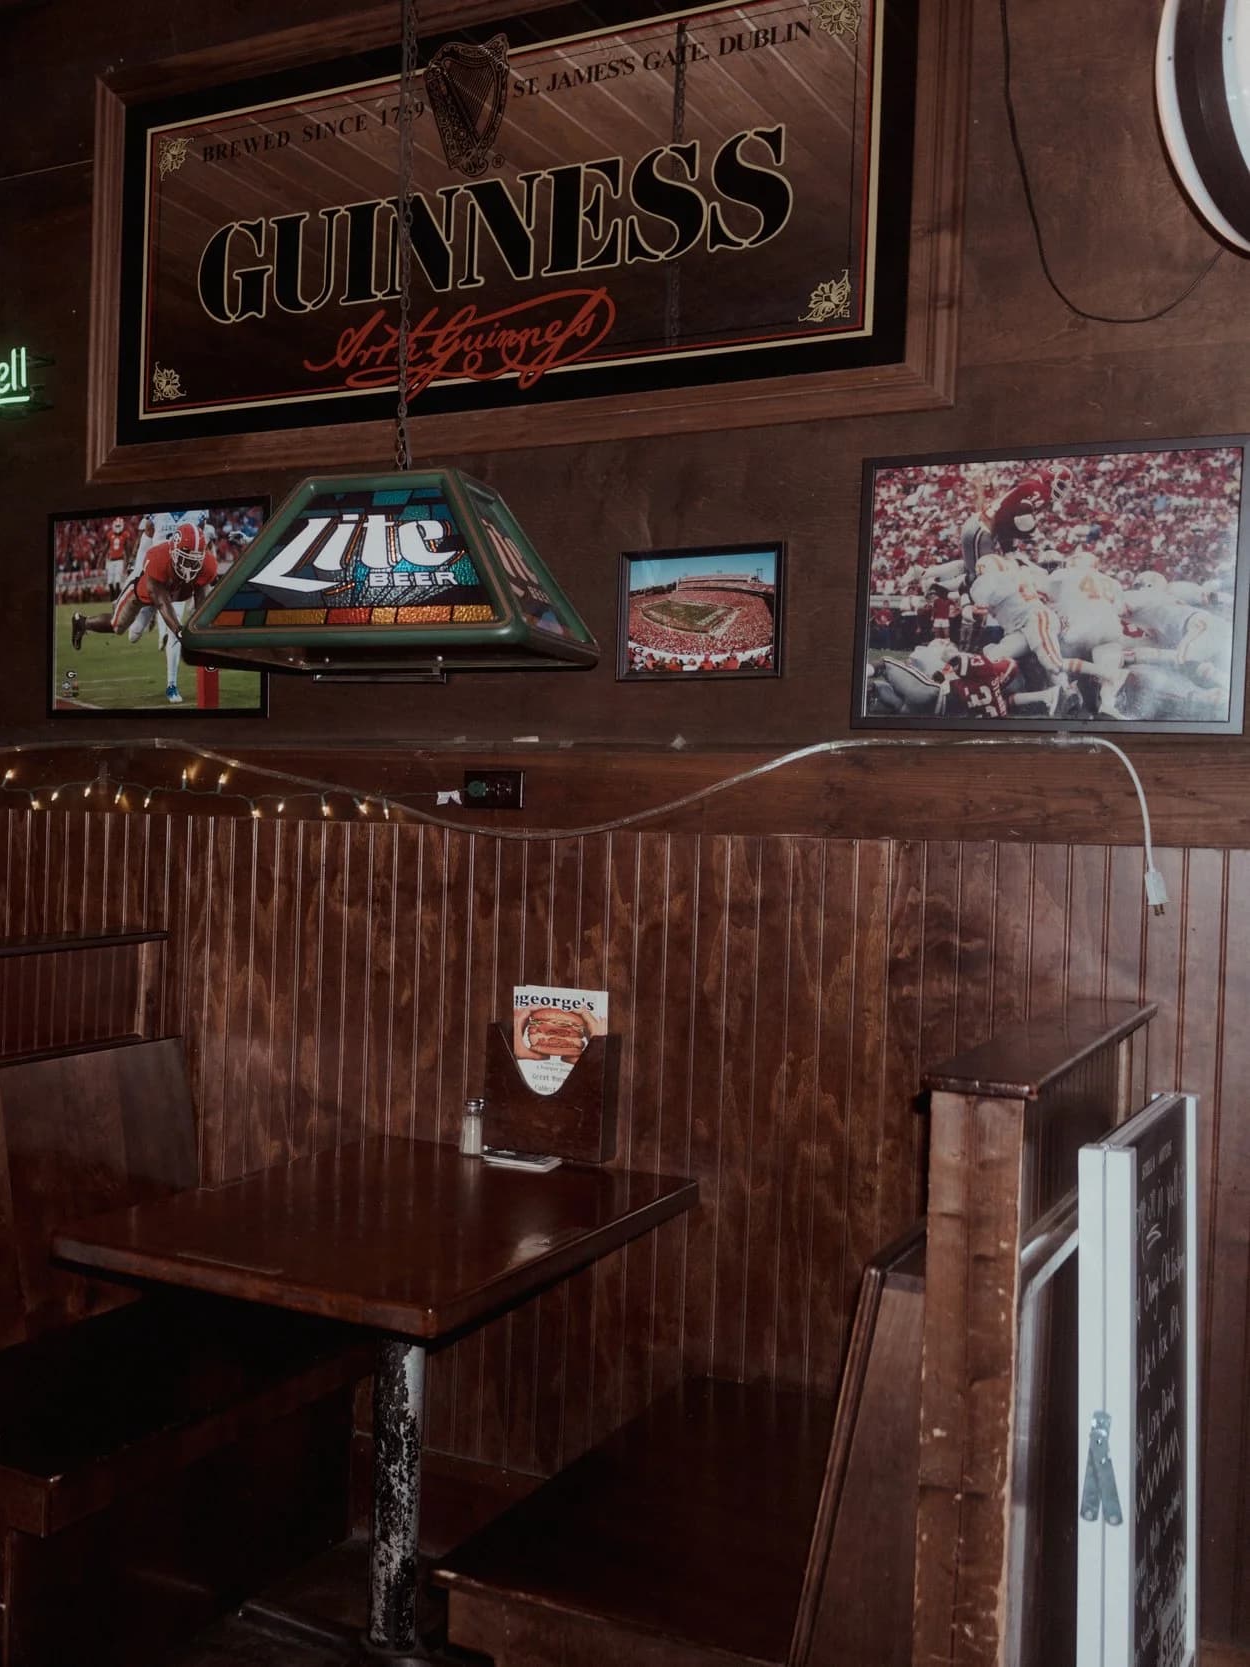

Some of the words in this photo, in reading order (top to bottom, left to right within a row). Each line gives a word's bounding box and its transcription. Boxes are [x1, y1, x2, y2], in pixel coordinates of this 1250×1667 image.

[718, 19, 812, 56] DUBLIN
[201, 130, 291, 163] BREWED
[301, 113, 368, 143] SINCE
[380, 100, 426, 127] 179
[197, 124, 795, 325] GUINNESS
[247, 513, 461, 593] Lite
[368, 572, 458, 588] BEER
[519, 994, 595, 1012] george's
